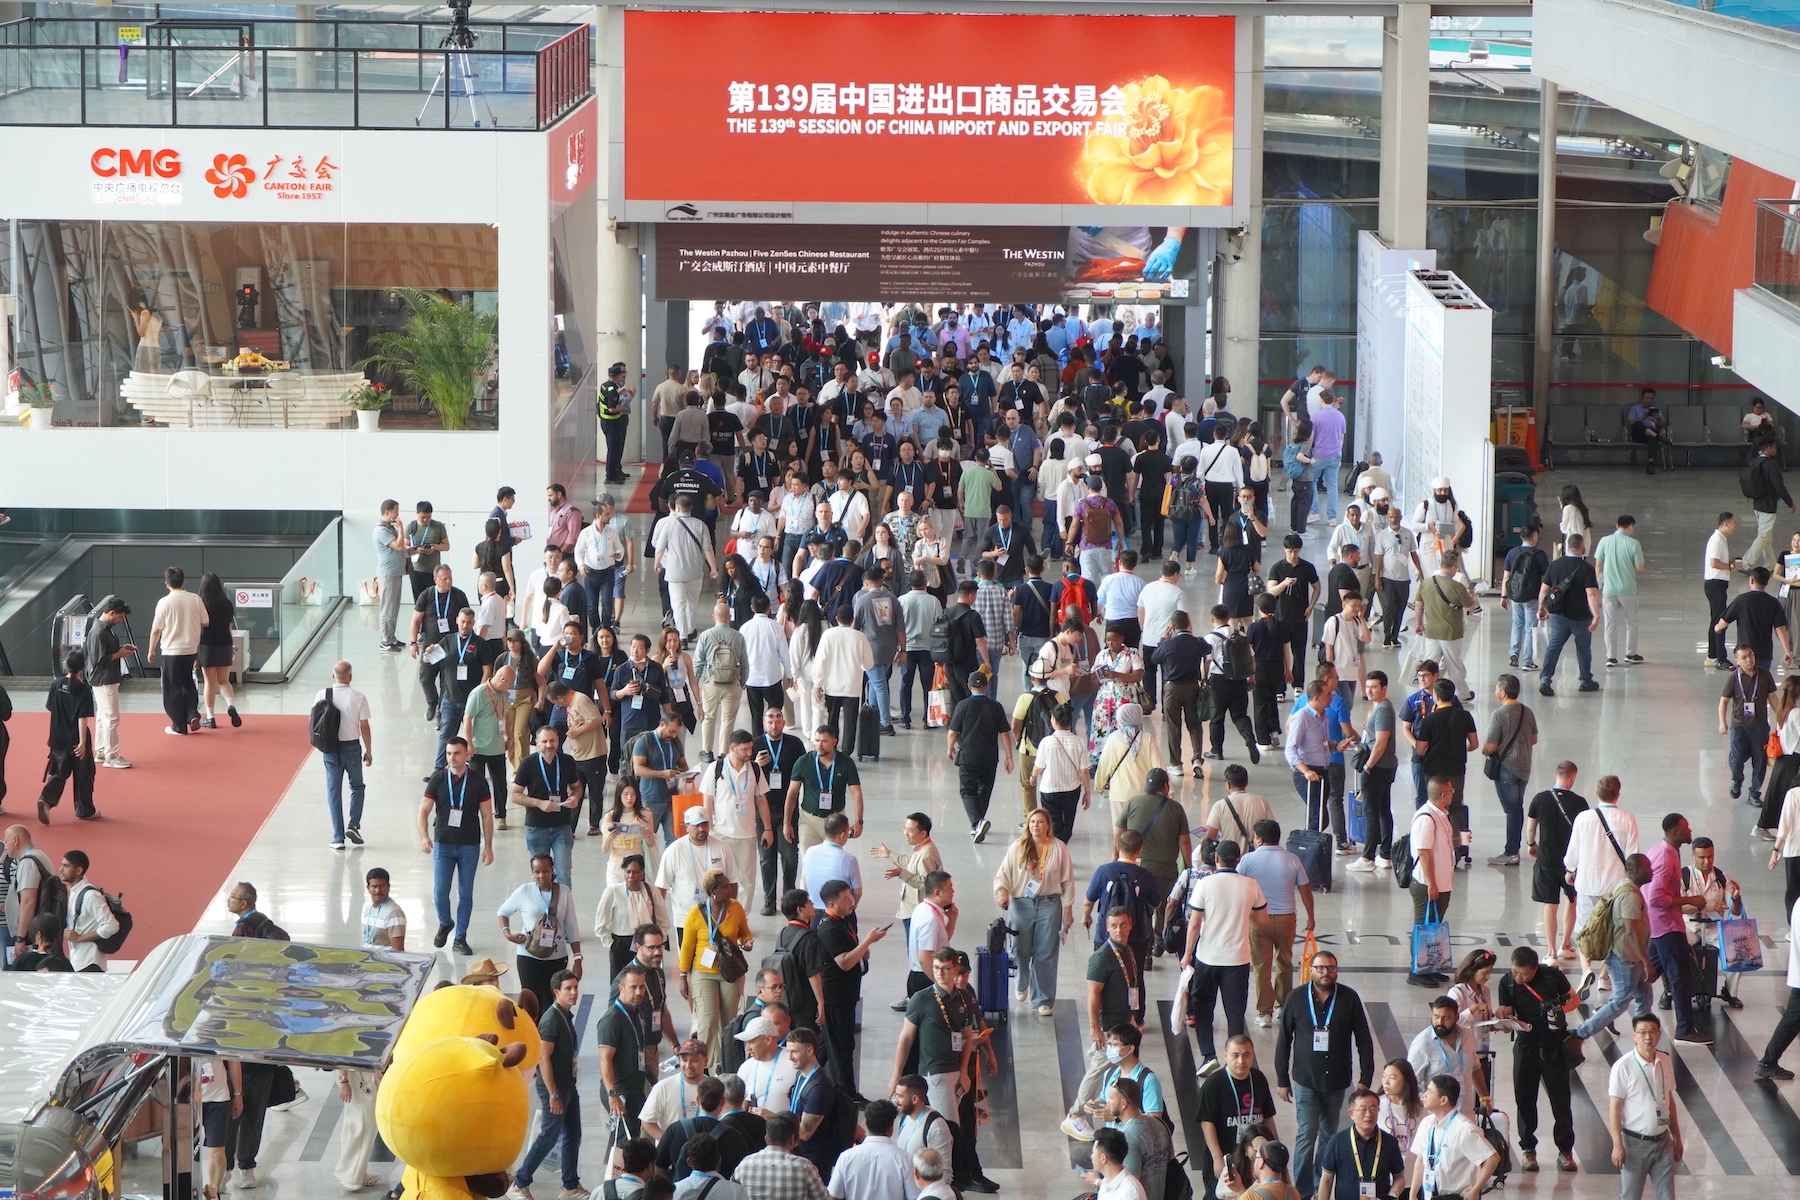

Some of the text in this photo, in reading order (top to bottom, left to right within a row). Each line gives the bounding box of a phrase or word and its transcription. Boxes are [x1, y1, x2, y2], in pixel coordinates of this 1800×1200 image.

[727, 80, 1128, 117] 第139届中国进出口商品交易会
[727, 117, 1128, 137] THE 139th SESSION OF CHINA IMPORT AND EXPORT FAIR
[90, 148, 181, 178] CMG
[263, 154, 339, 180] 广交会
[93, 182, 180, 194] 中央广播电视总台
[263, 182, 332, 191] CANTON FAIR
[116, 195, 136, 203] CNR
[277, 192, 322, 200] Since 1957
[679, 249, 694, 257] The
[694, 249, 721, 257] Westin
[798, 250, 828, 258] Chinese
[829, 250, 870, 258] Restaurant
[1002, 249, 1065, 259] THE WESTIN
[679, 261, 850, 274] 广交会威斯汀酒店 中国元素中餐厅
